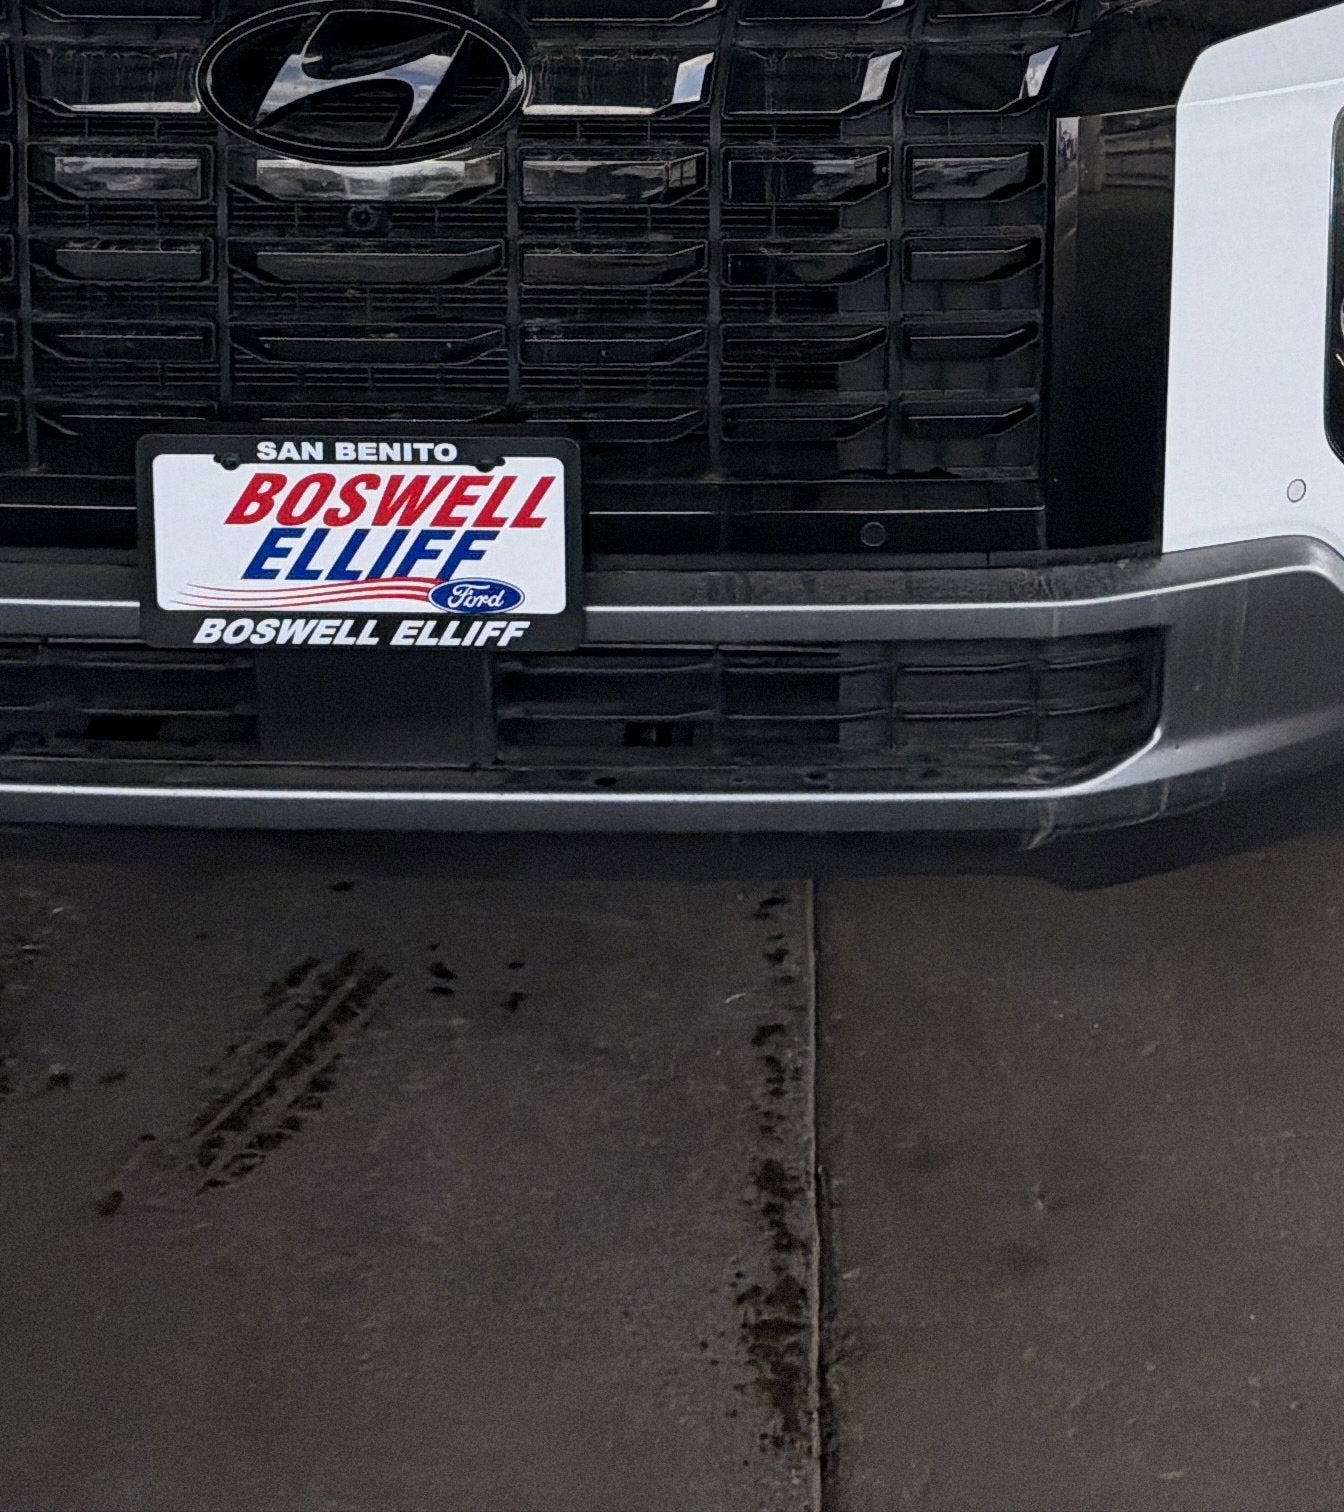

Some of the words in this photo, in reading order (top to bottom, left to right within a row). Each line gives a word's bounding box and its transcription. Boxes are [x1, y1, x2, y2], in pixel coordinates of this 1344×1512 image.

[256, 441, 323, 462] SAN
[335, 442, 458, 463] BENITO
[223, 472, 557, 528] BOSWELL
[240, 528, 501, 581] ELLIFF
[447, 584, 506, 609] Ford
[192, 618, 381, 646] BOSWELL
[389, 619, 531, 648] ELLIFF
